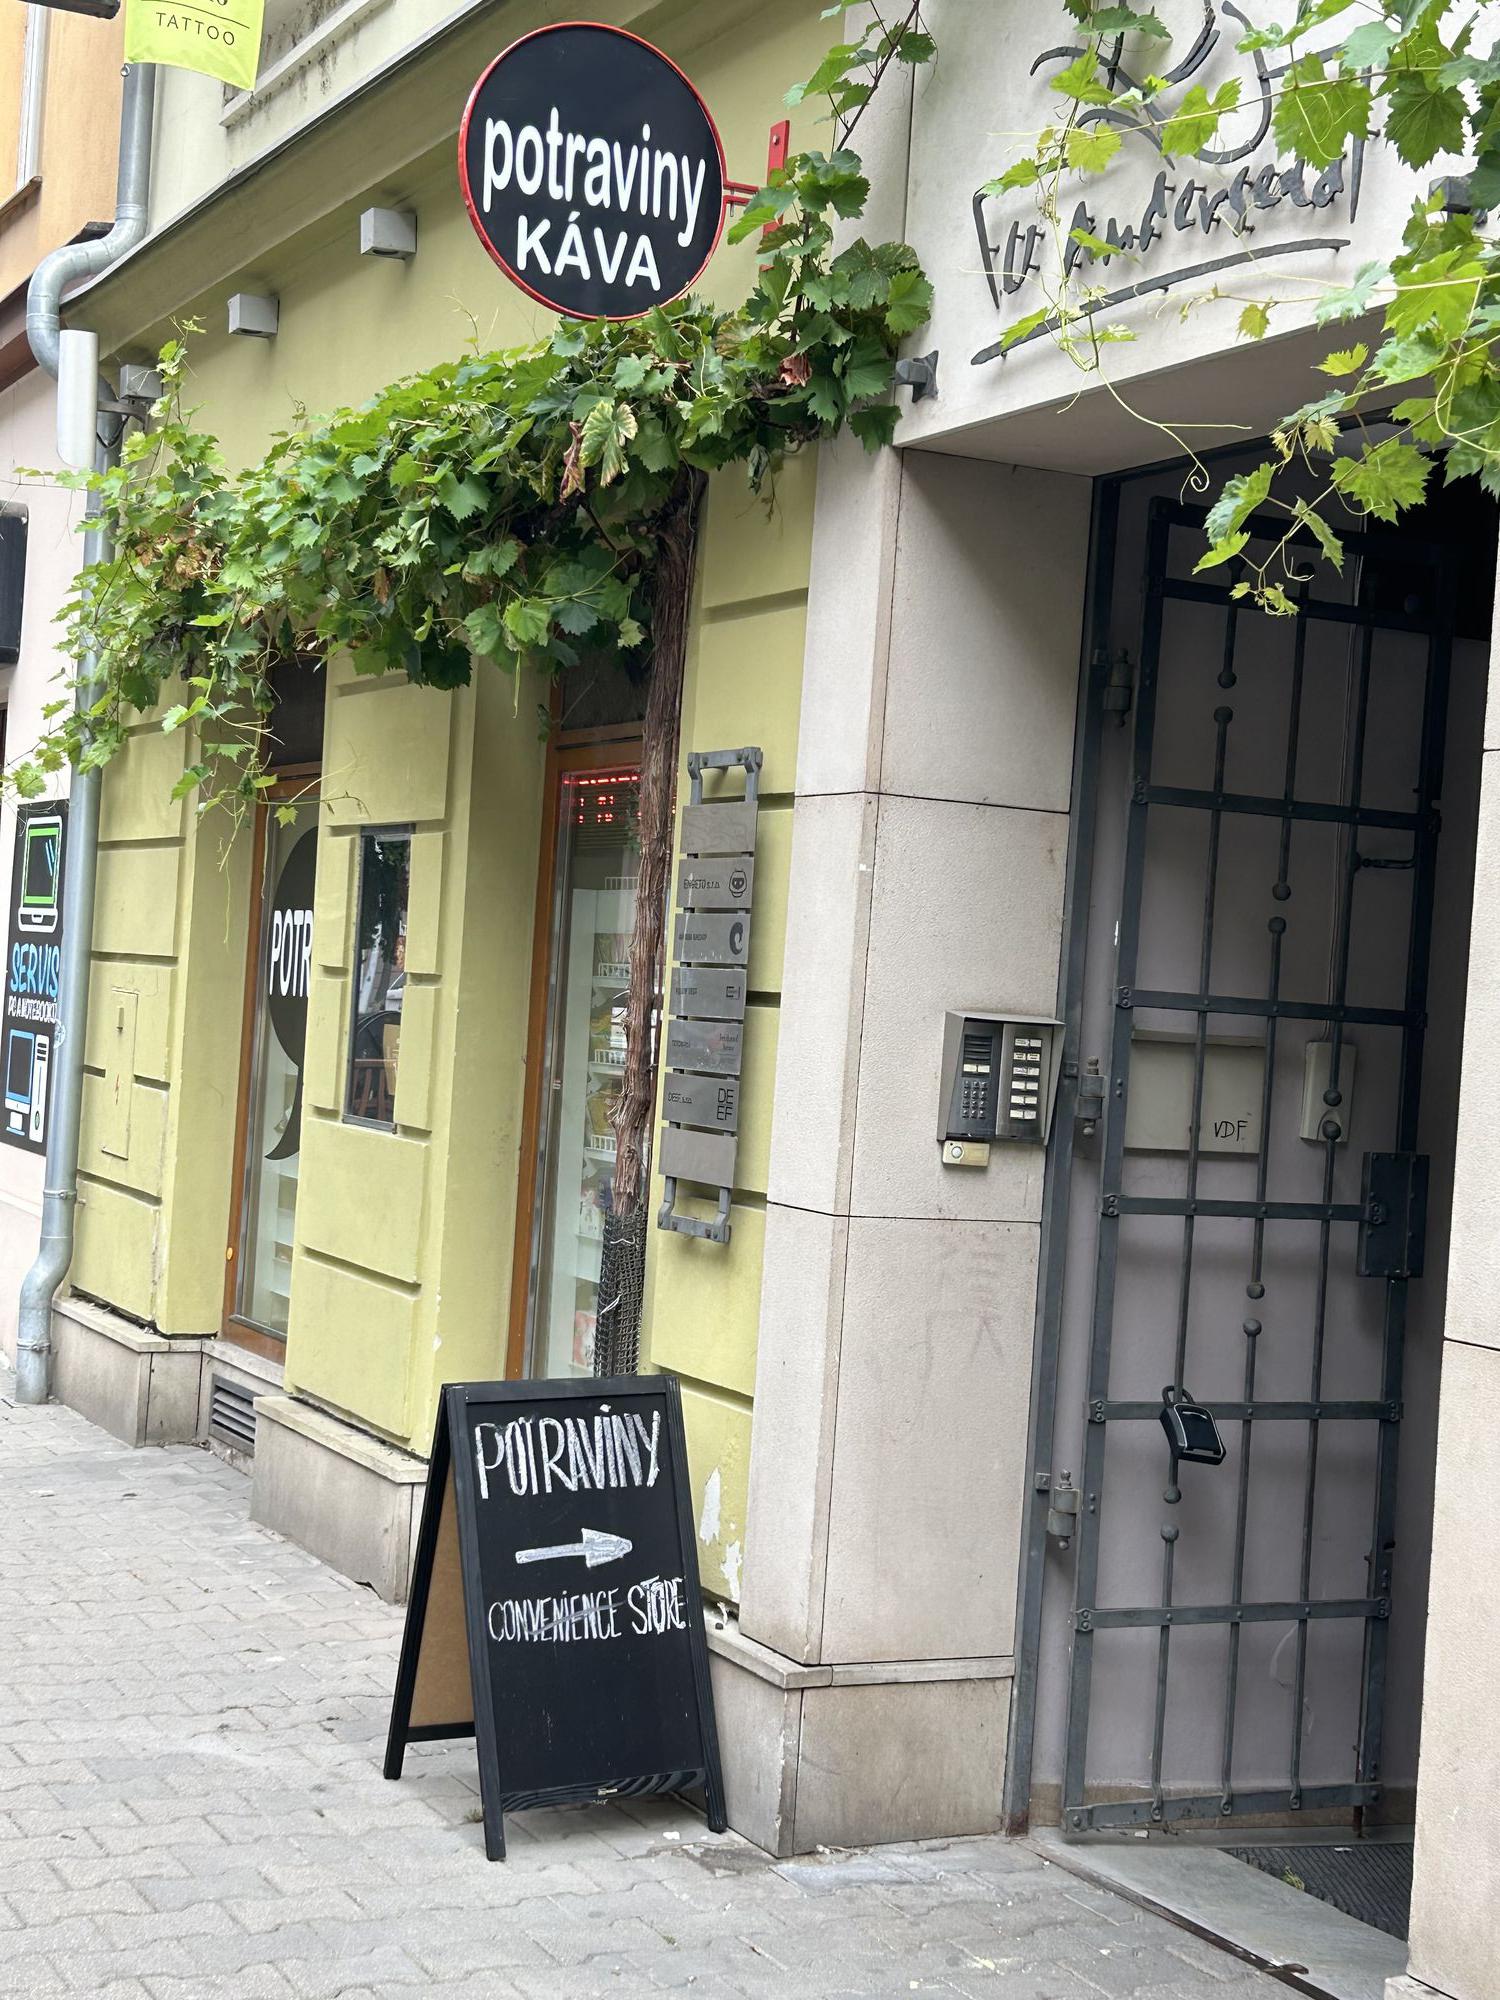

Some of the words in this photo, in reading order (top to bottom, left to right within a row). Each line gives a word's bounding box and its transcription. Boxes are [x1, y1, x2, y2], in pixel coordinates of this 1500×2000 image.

[155, 12, 235, 46] TATTOO
[481, 105, 707, 249] potraviny
[515, 209, 662, 292] KÁVA
[10, 942, 60, 998] SERVIS
[269, 908, 314, 998] POTR
[716, 1105, 733, 1121] EF
[717, 1087, 734, 1105] DE
[1214, 1119, 1249, 1140] VDF
[627, 1575, 687, 1635] STORE
